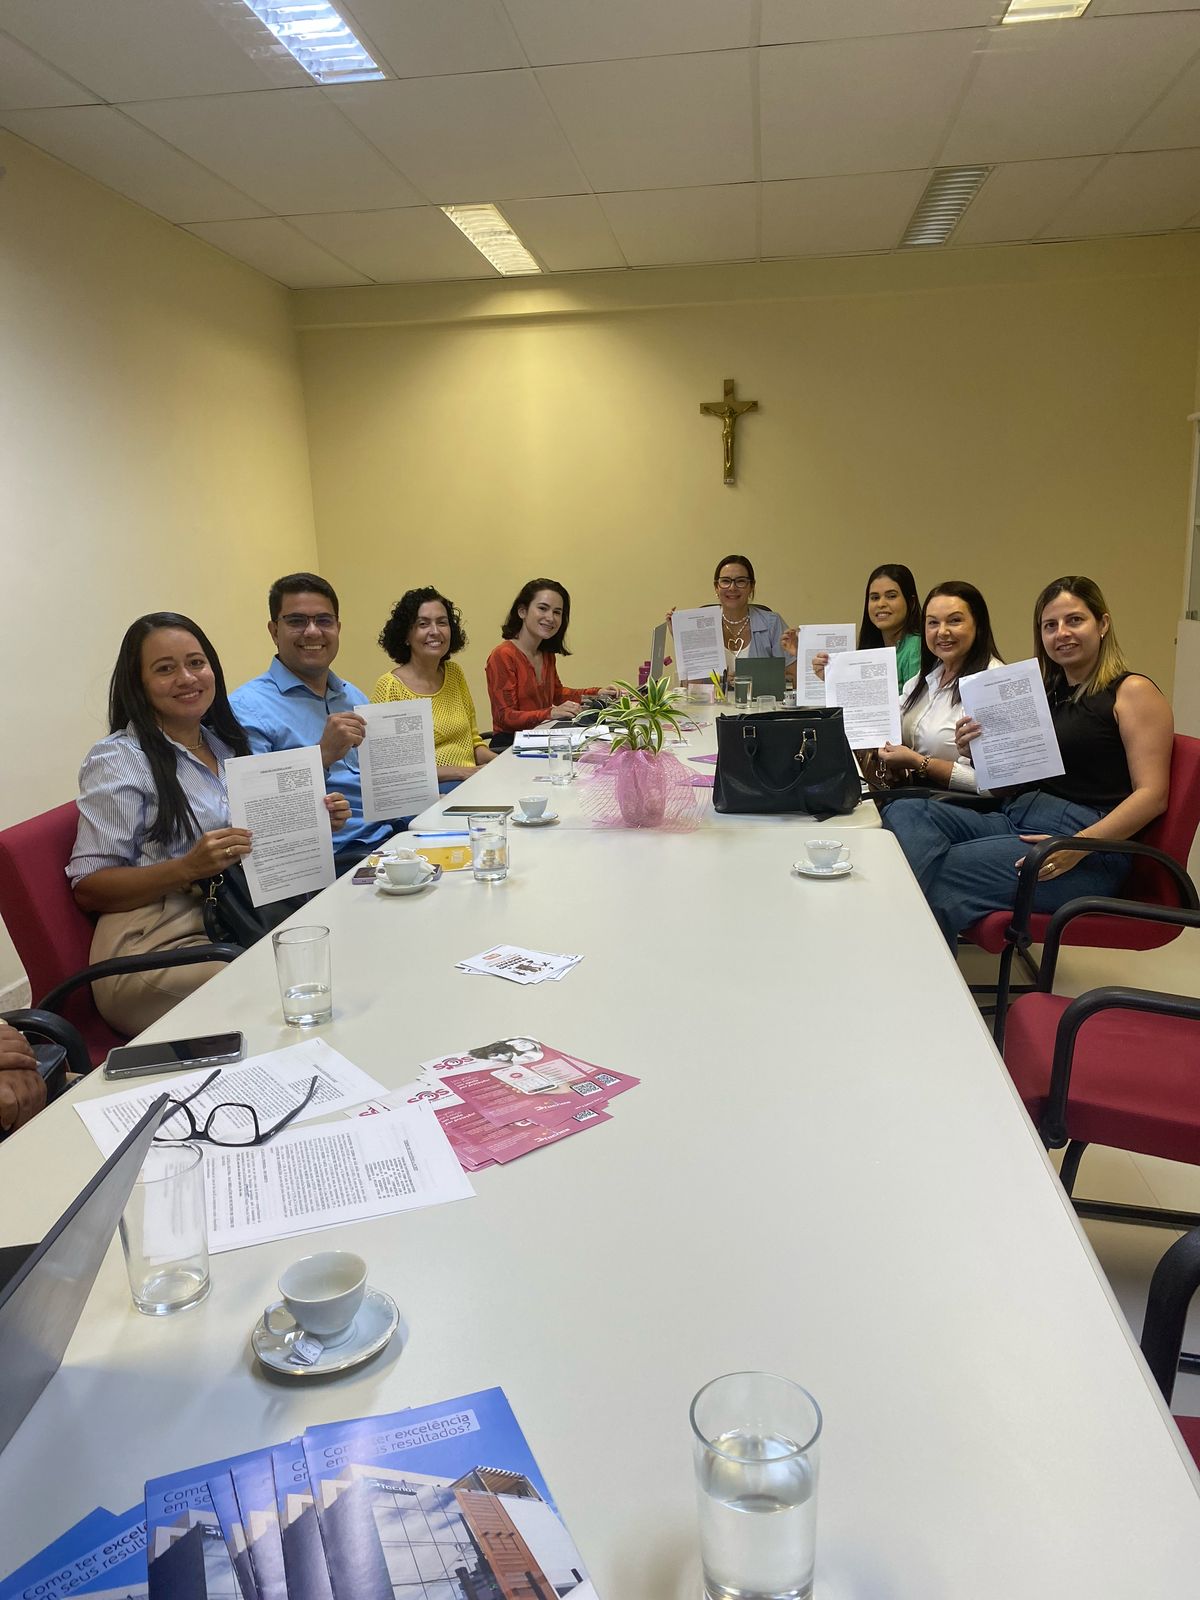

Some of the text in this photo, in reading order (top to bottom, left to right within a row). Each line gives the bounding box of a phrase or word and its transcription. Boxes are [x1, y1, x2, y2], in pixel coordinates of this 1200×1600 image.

[391, 1421, 471, 1451] resultados?
[395, 1412, 470, 1439] excelência
[23, 1570, 72, 1600] Como
[75, 1554, 97, 1571] ter
[61, 1566, 99, 1594] seus
